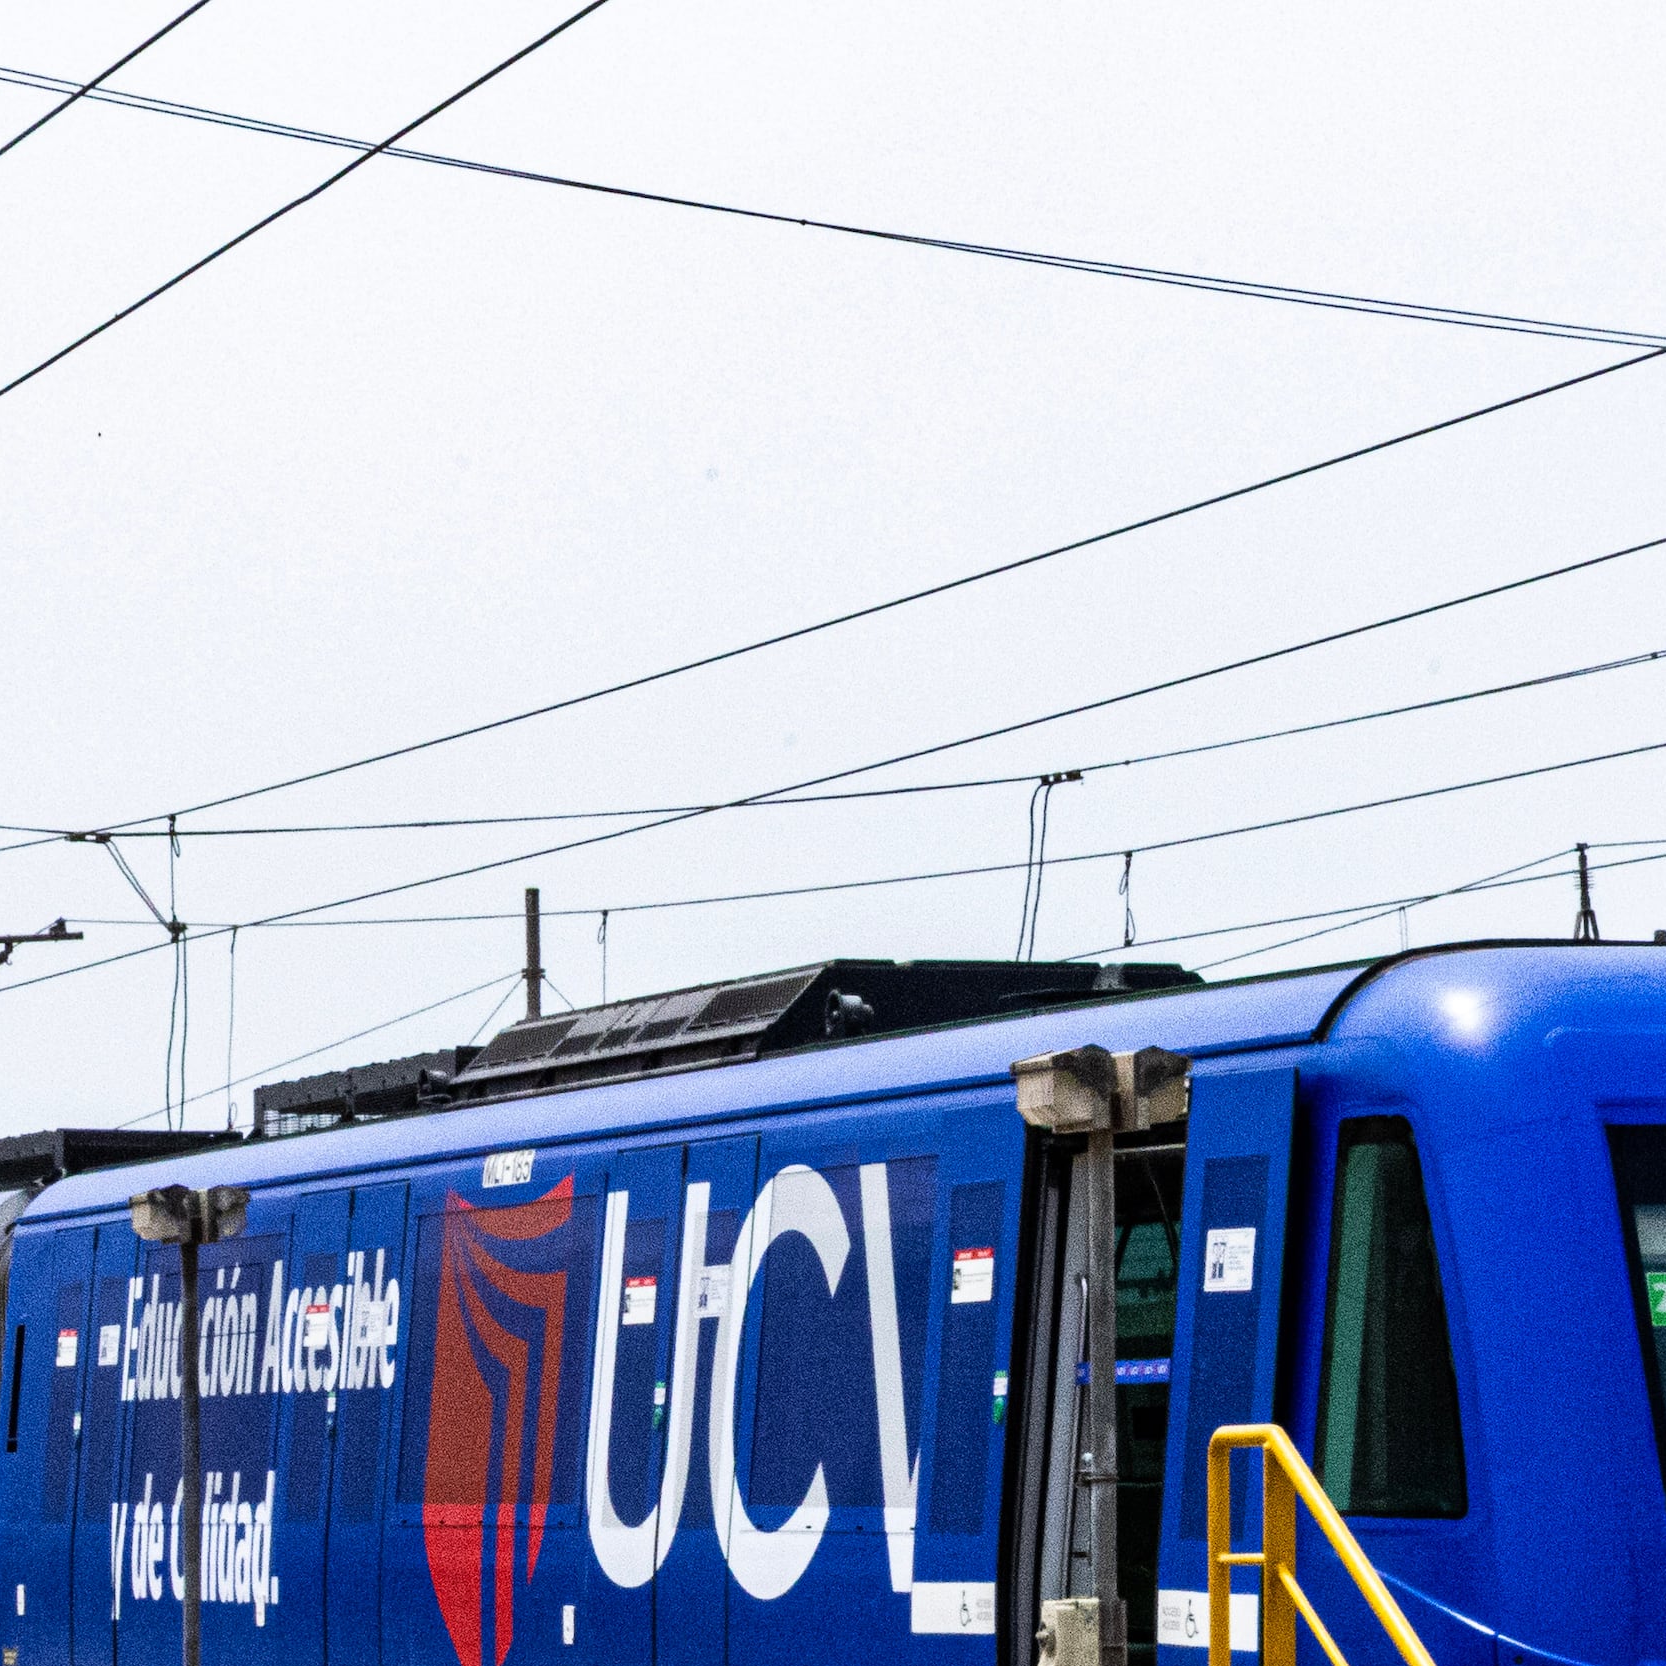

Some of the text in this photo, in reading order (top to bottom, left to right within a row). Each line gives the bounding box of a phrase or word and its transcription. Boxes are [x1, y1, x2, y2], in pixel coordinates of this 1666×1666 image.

[121, 1249, 400, 1400] Educción Accesible
[111, 1470, 279, 1620] y de Clidad.
